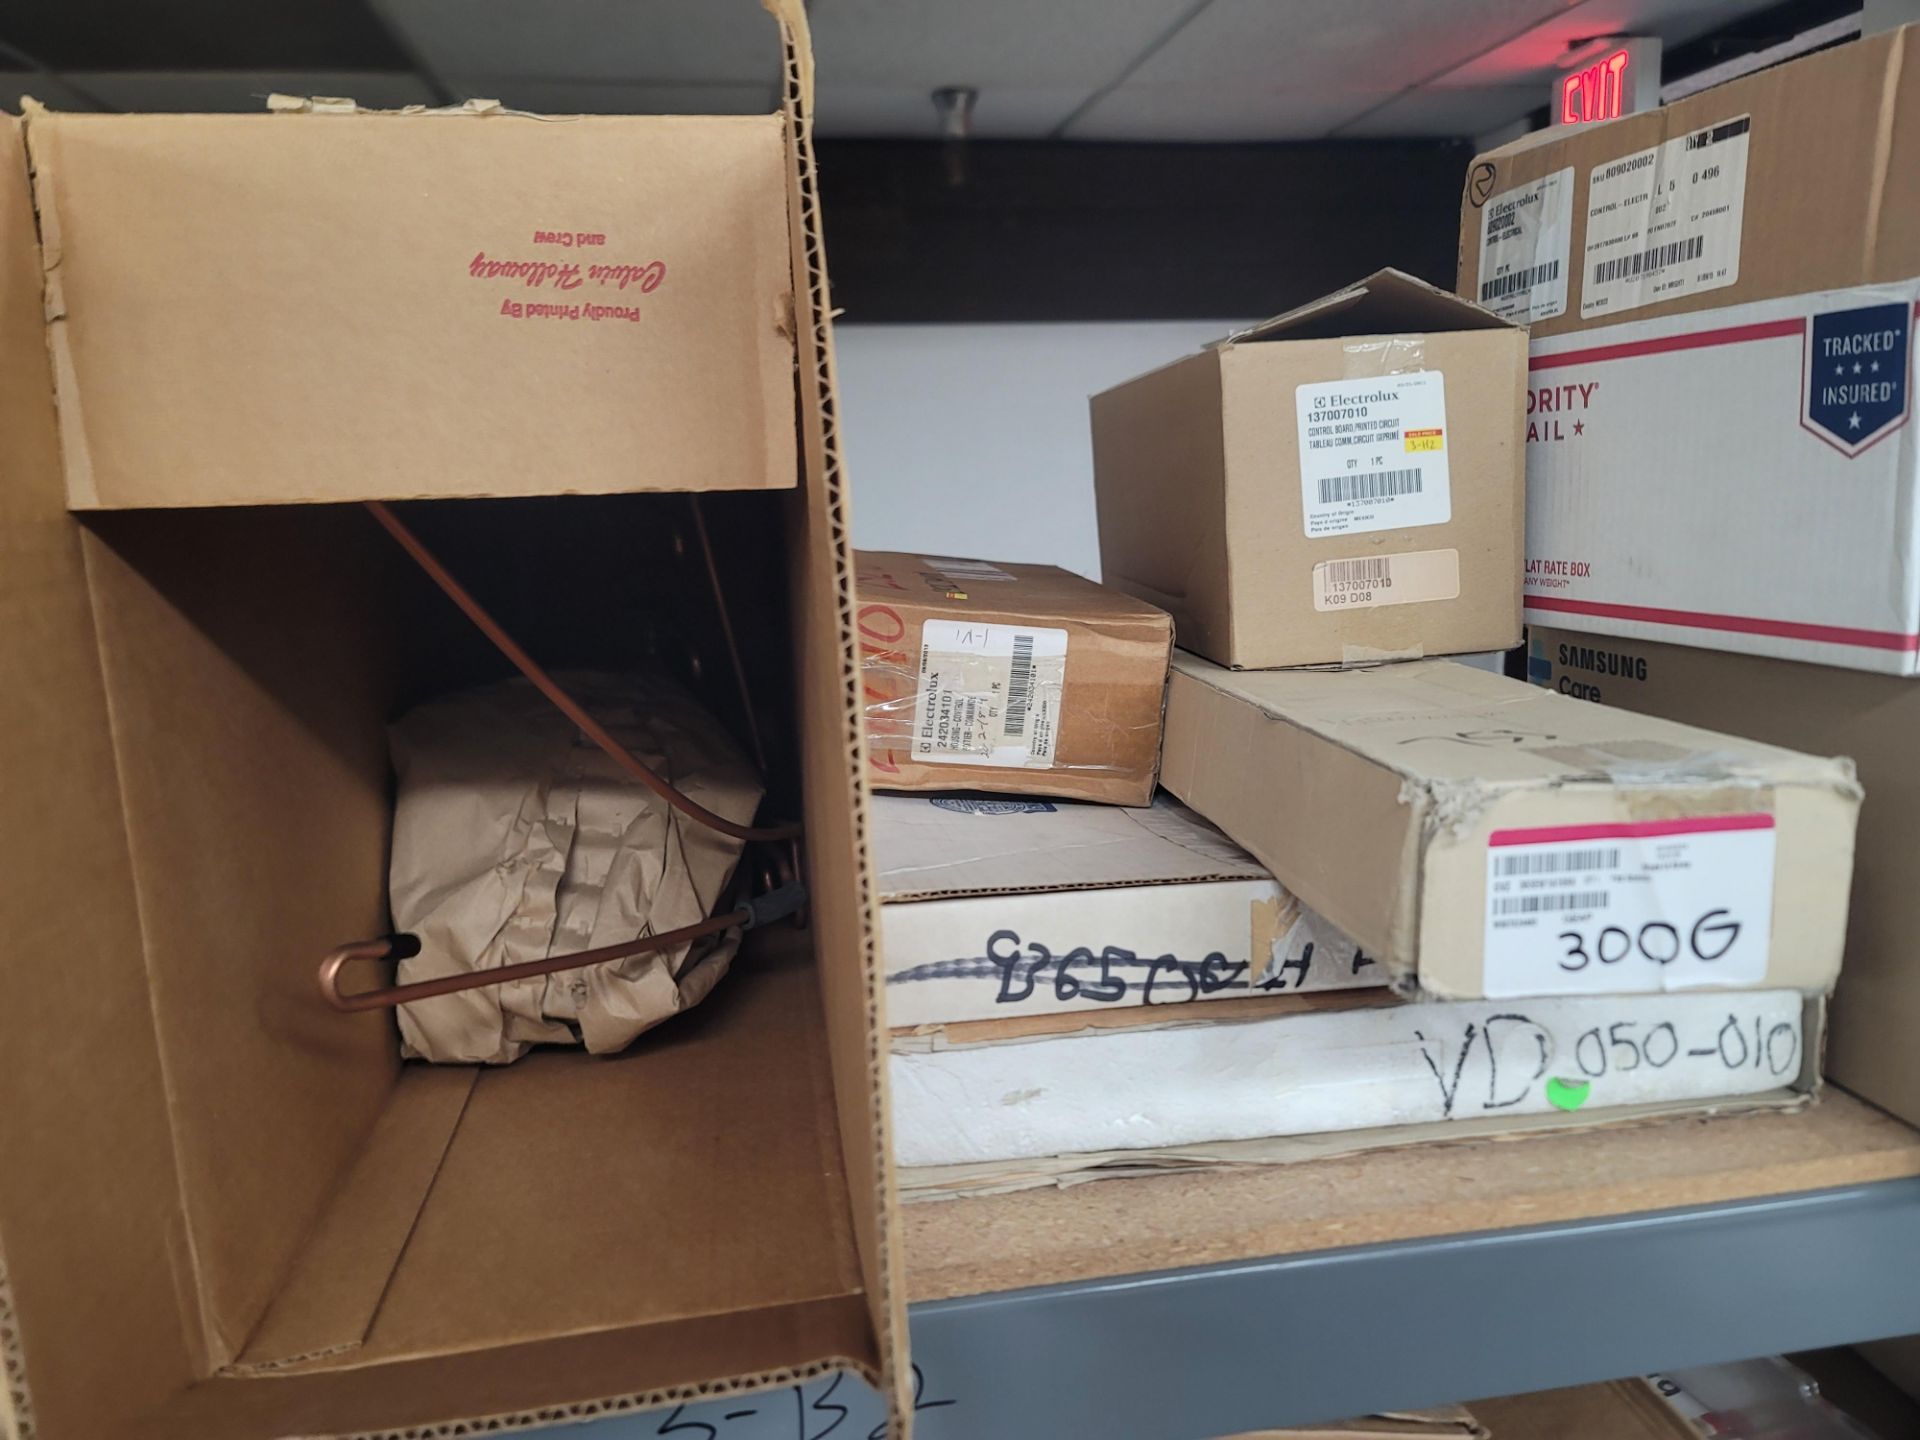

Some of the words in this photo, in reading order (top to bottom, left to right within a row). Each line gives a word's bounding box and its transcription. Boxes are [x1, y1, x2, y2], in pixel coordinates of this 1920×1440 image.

[1702, 165, 1720, 179] 496
[1495, 192, 1539, 216] Electrolux
[533, 231, 574, 247] Crew
[576, 233, 606, 248] and
[469, 251, 584, 290] Holloway
[588, 261, 666, 293] Calvin
[500, 299, 523, 318] By
[526, 302, 580, 320] Printed
[582, 302, 640, 322] Proudly
[1823, 330, 1894, 357] TRACKED
[1330, 390, 1400, 407] Electrolux
[1822, 381, 1891, 405] INSURED
[1307, 407, 1368, 423] 137007010
[1308, 423, 1334, 437] CONTROL
[1378, 418, 1400, 429] CIRCUIT
[1309, 437, 1334, 449] TABLEAU
[1346, 459, 1357, 469] QTY
[1524, 559, 1542, 574] LAT
[1543, 559, 1568, 576] RATE
[1570, 562, 1591, 578] BOX
[1332, 578, 1392, 592] 137007010
[1324, 595, 1347, 605] K09
[1350, 591, 1372, 603] D08
[1559, 643, 1647, 681] SAMSUNG
[1559, 675, 1601, 703] Care
[921, 672, 939, 738] Electrolux
[937, 690, 952, 748] 242034101
[1414, 1013, 1555, 1121] VD
[1575, 1014, 1797, 1077] 050-010
